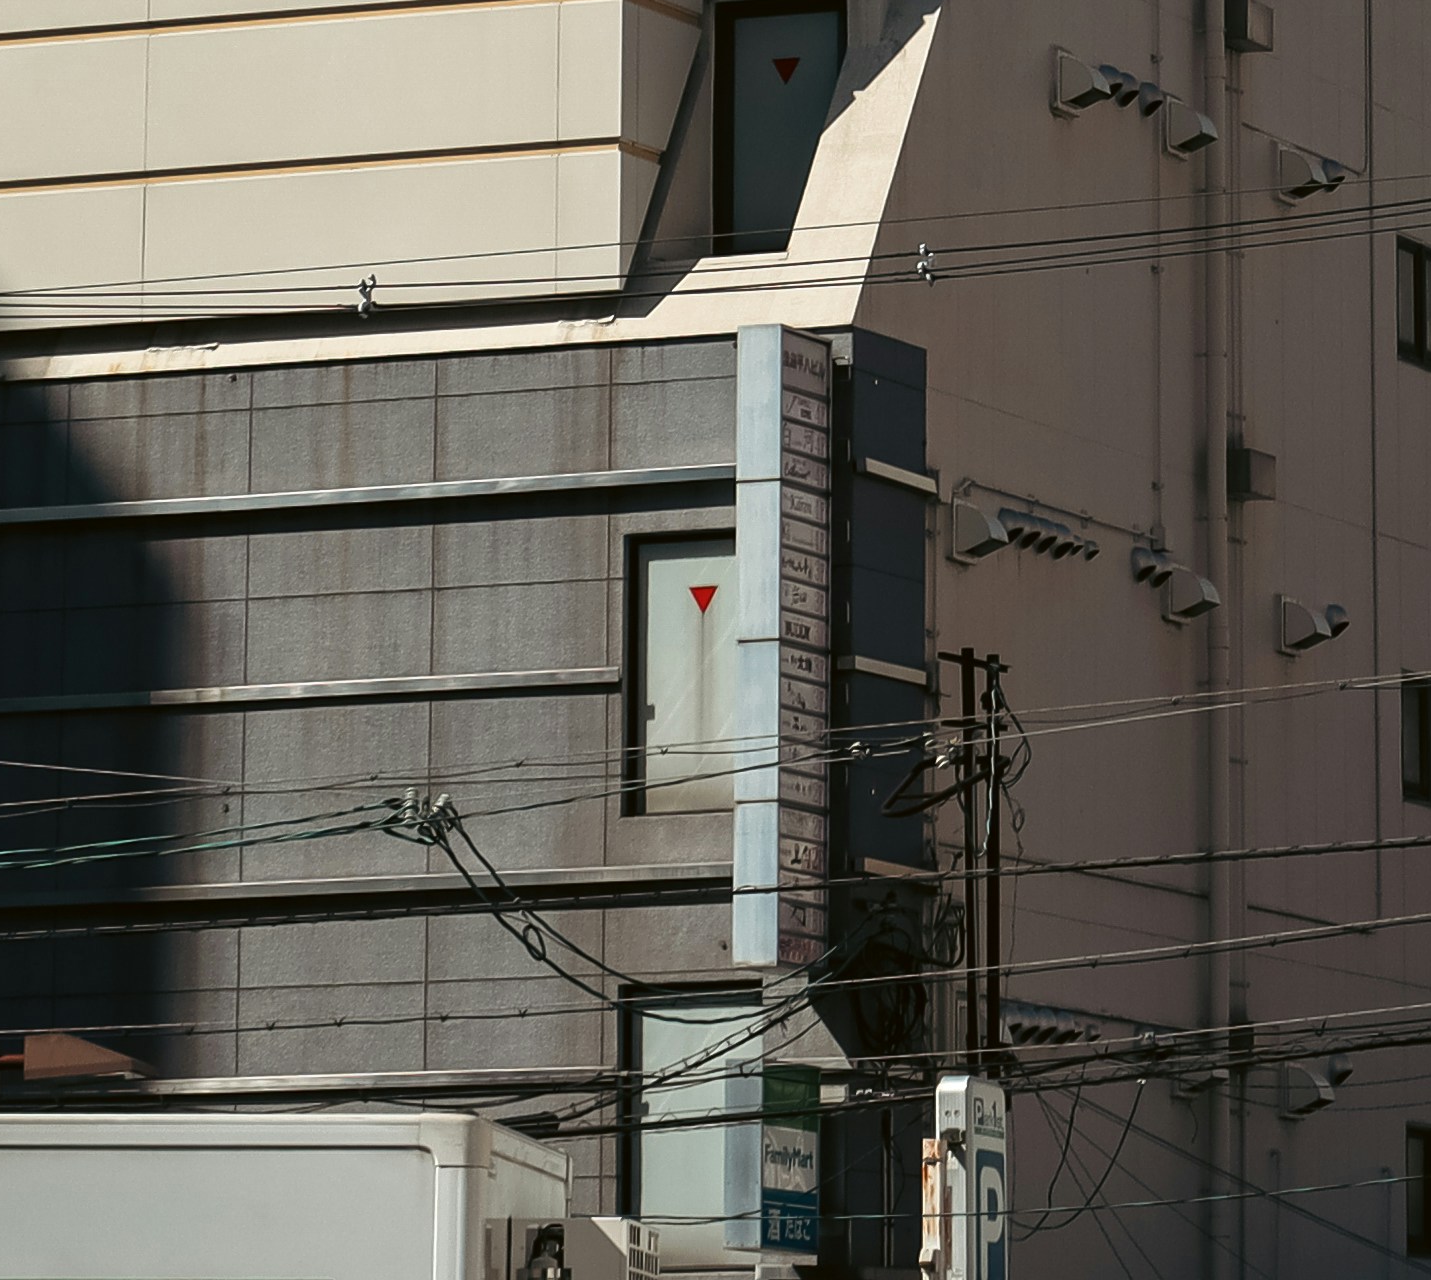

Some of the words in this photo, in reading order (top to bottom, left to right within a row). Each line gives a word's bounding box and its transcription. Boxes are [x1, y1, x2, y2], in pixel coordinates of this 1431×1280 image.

[764, 1142, 814, 1173] FamilyMart
[766, 1207, 782, 1242] 酒
[784, 1212, 812, 1242] たばこ
[979, 1165, 1004, 1280] P
